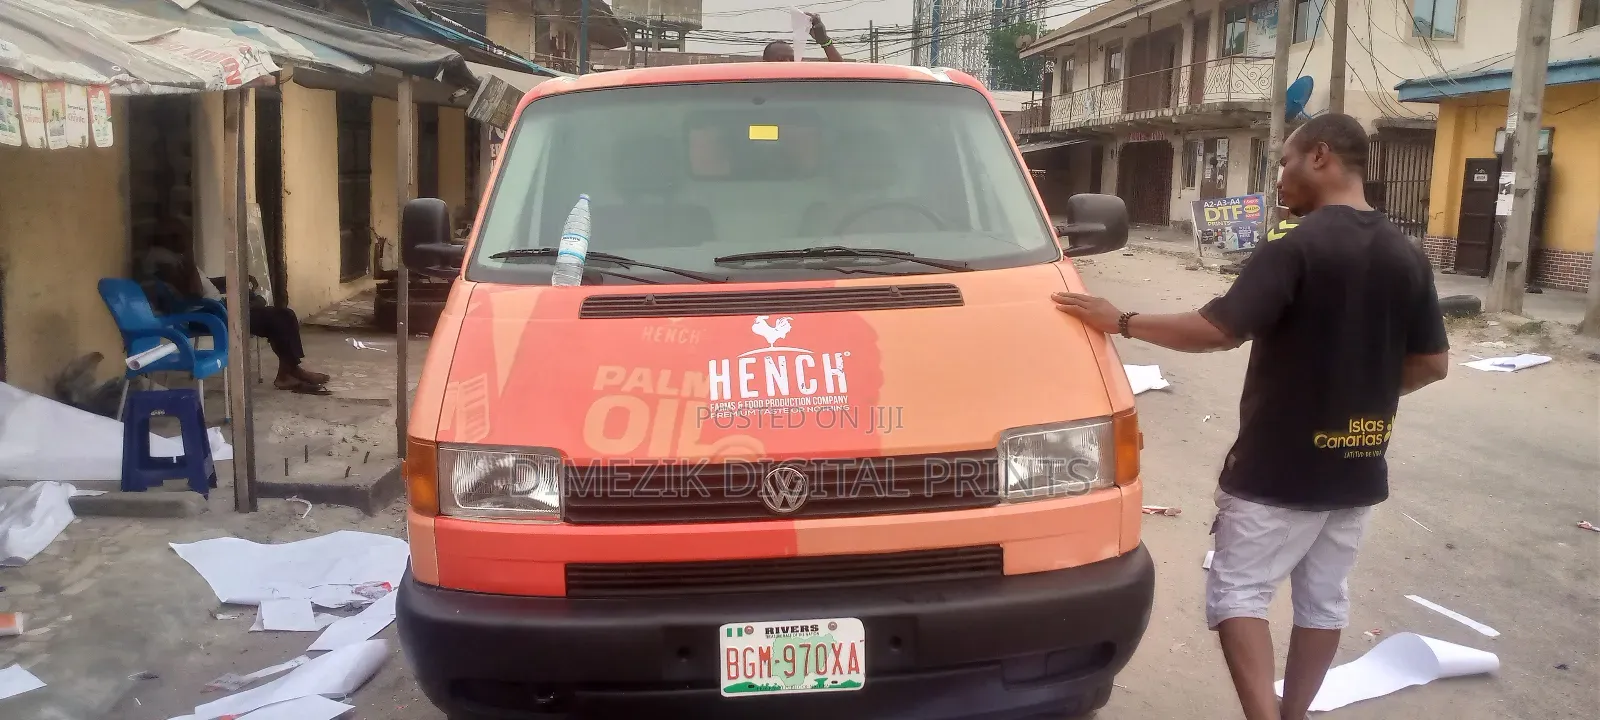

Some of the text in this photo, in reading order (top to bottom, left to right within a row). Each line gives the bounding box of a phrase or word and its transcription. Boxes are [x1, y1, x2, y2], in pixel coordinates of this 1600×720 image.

[1204, 198, 1240, 208] A2-A3-A4
[1204, 205, 1243, 222] DTF
[641, 325, 701, 345] HENCH
[593, 365, 722, 398] PALM
[709, 352, 848, 400] HENCH
[710, 395, 848, 412] FARMS & FOOD PRODUCTION COMPANY
[710, 404, 850, 419] PREMIUM TASTE OR NOTHING
[582, 394, 715, 459] OIL
[1349, 417, 1384, 433] Islas
[1313, 432, 1383, 449] Canarias
[764, 624, 820, 635] RIVERS
[726, 642, 860, 680] BGM-970XA
